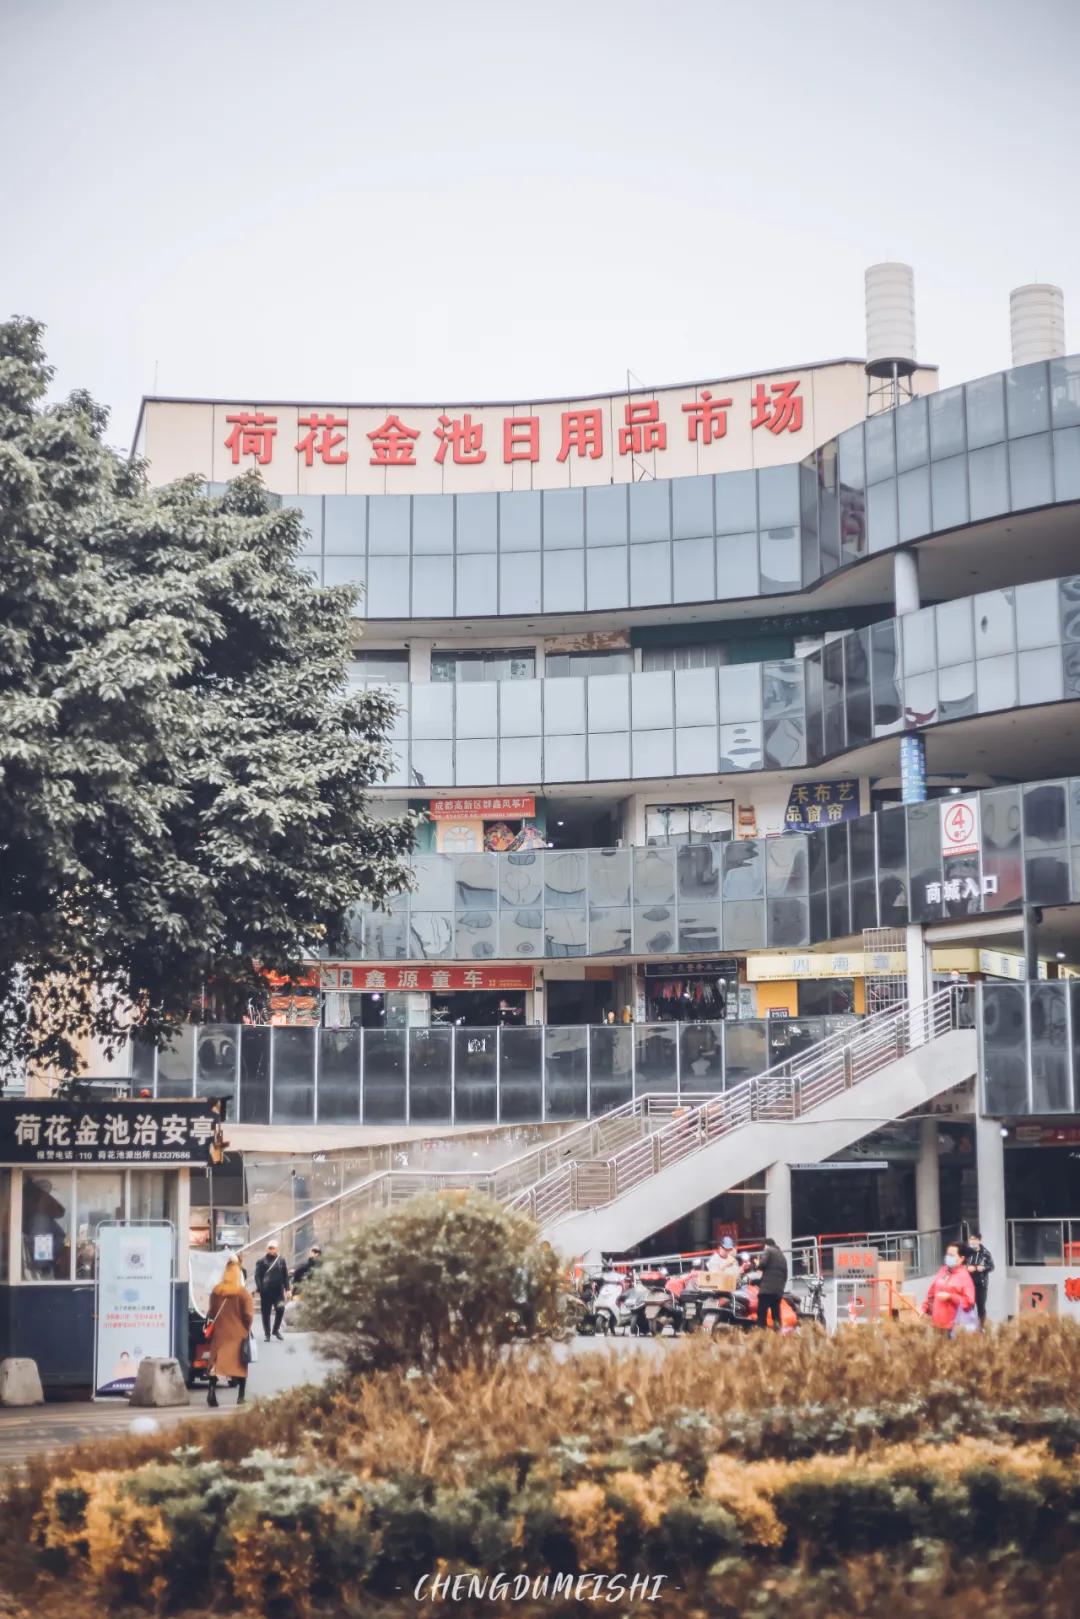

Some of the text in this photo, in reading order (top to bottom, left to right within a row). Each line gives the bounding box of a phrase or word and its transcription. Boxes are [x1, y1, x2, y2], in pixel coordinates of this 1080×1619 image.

[224, 379, 806, 467] 荷花金池日用品市场
[952, 808, 965, 829] 4
[925, 875, 998, 905] 商城入口
[364, 969, 484, 989] 鑫源童车
[15, 1113, 215, 1146] 荷花金池治安亭
